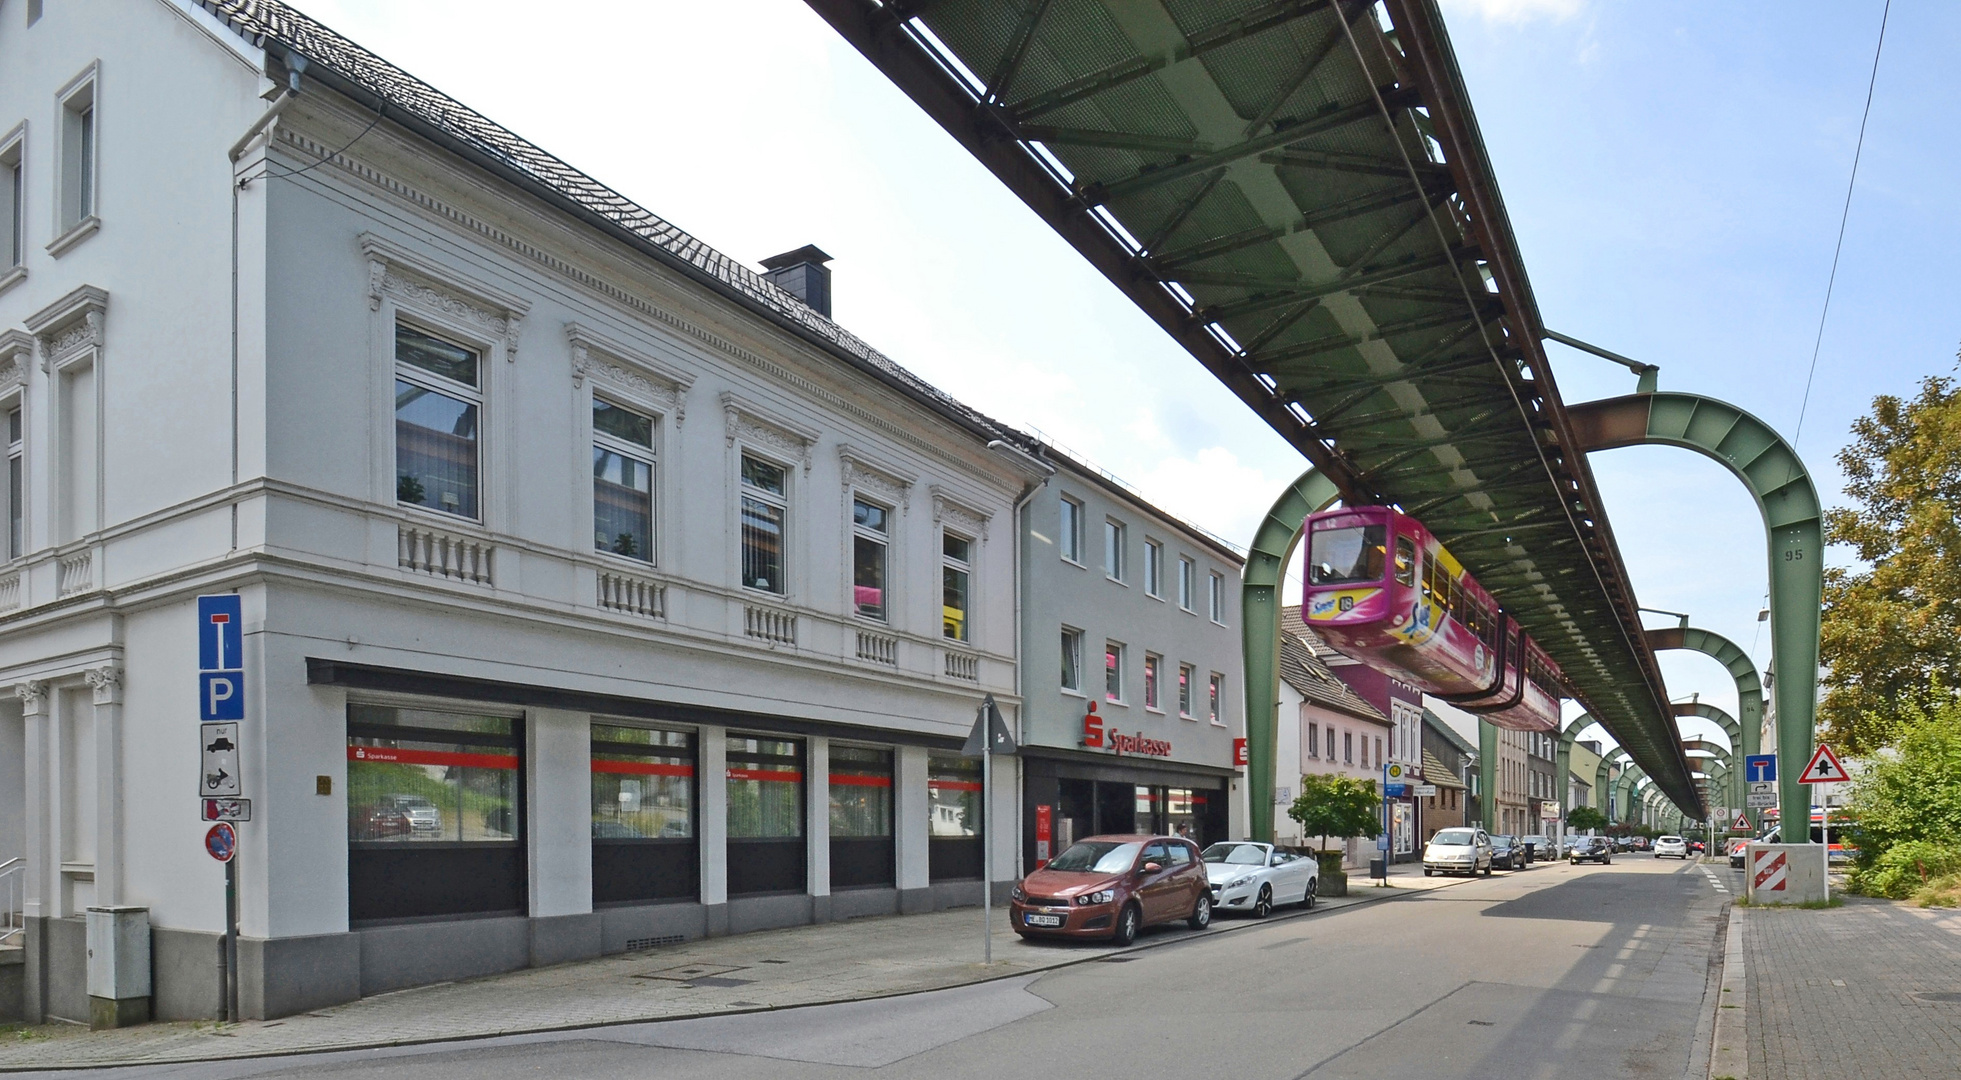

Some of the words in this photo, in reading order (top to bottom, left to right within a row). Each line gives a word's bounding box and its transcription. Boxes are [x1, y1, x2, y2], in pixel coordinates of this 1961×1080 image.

[1785, 549, 1803, 561] 95
[1340, 597, 1353, 610] 18
[210, 677, 233, 715] P
[1108, 727, 1172, 756] Sparkasse
